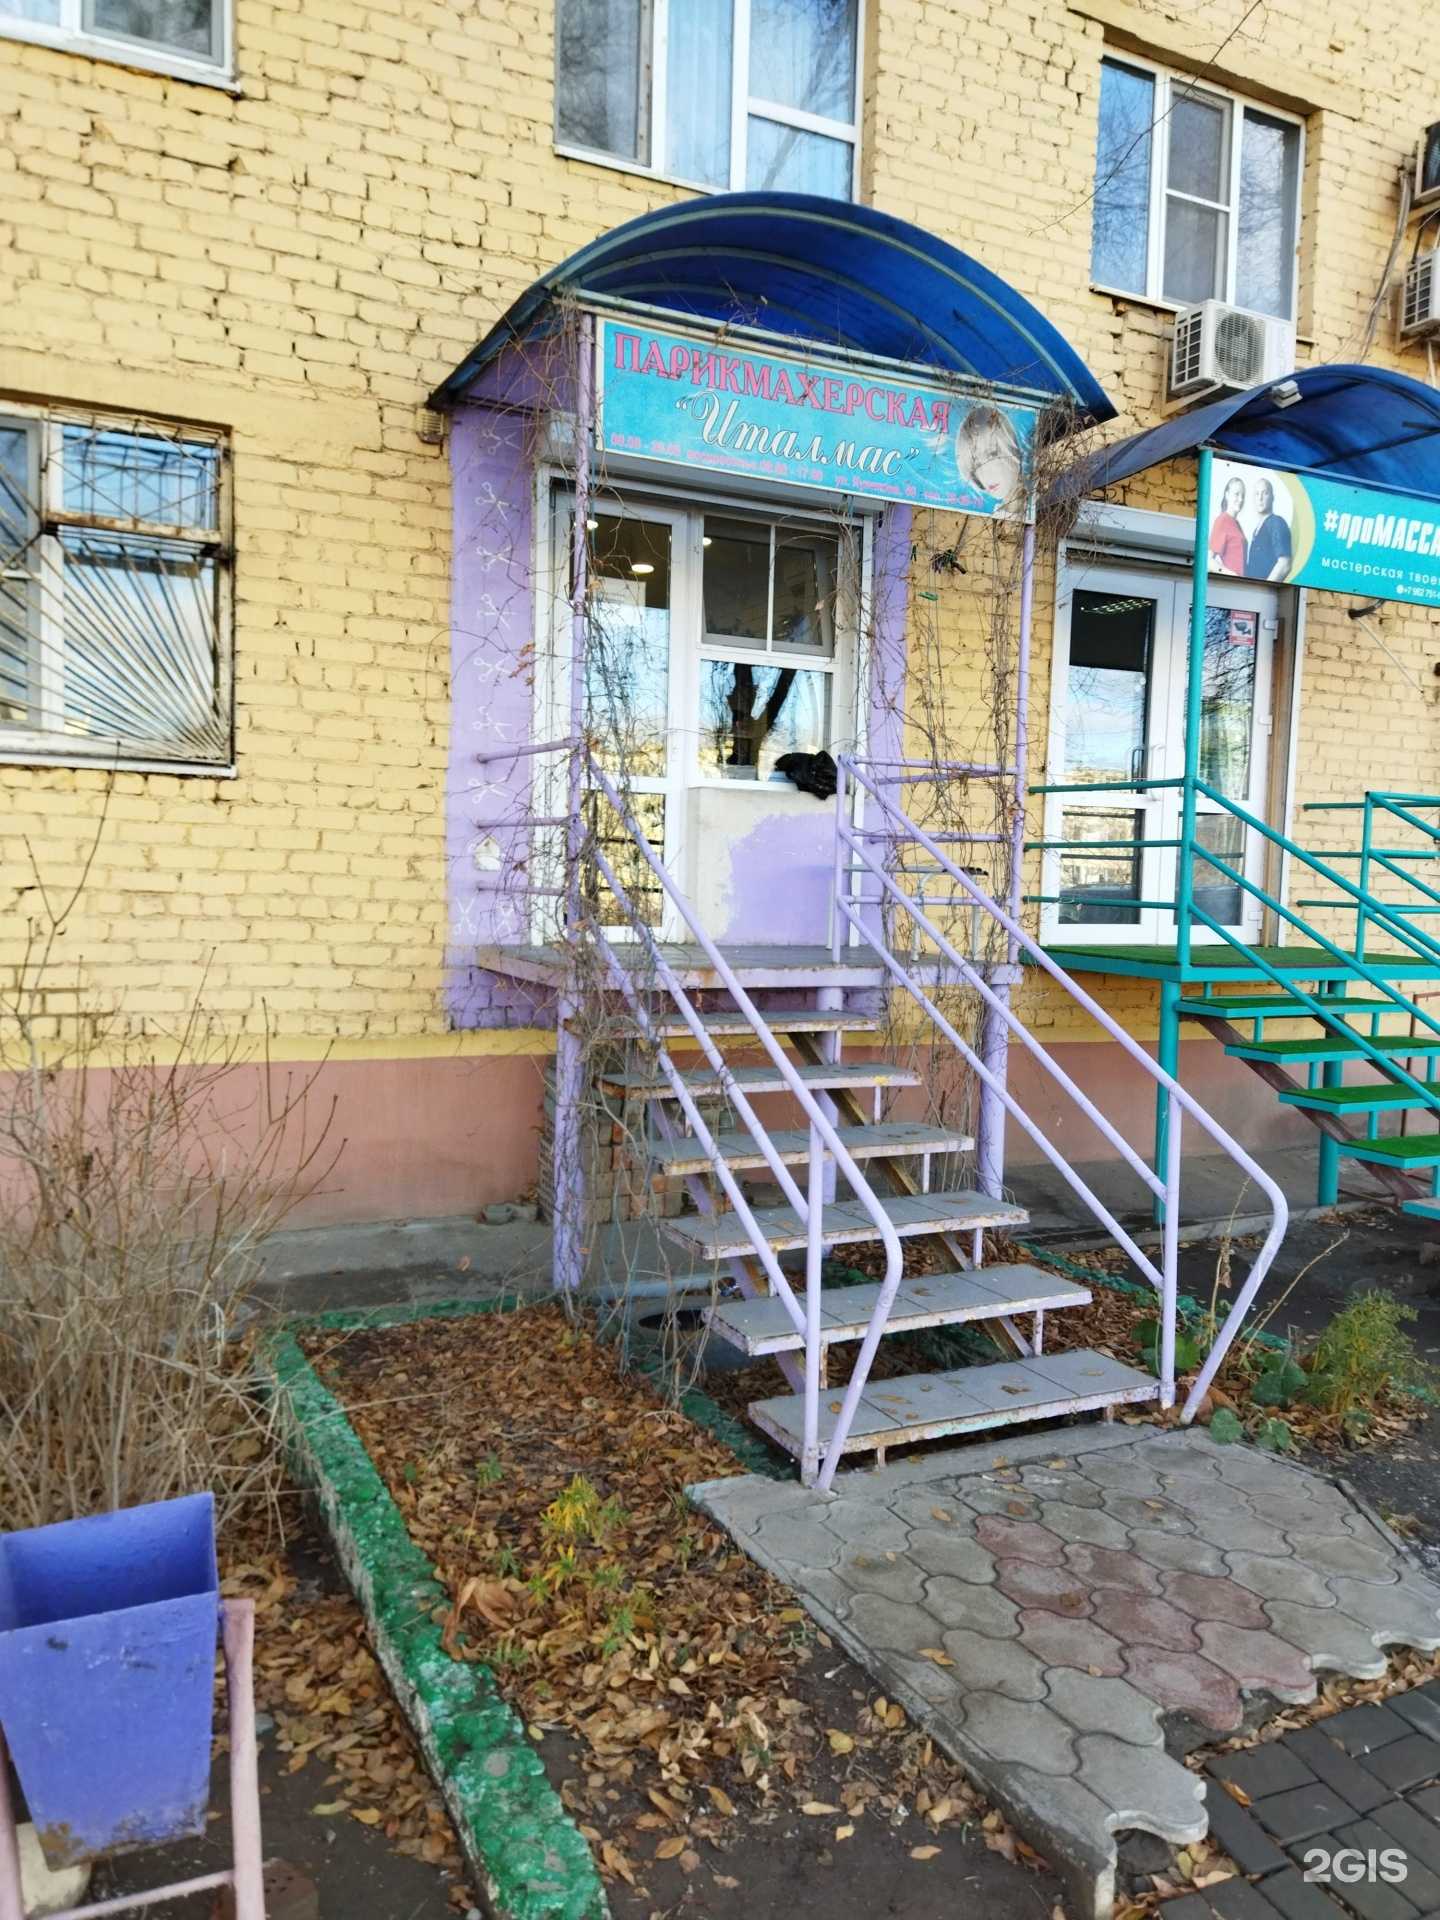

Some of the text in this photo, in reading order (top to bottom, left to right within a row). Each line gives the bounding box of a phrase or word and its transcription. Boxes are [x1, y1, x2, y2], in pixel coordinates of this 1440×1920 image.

[613, 332, 951, 433] ПАРИКМАХЕРСКАЯ
[1321, 556, 1440, 586] мастерская твое
